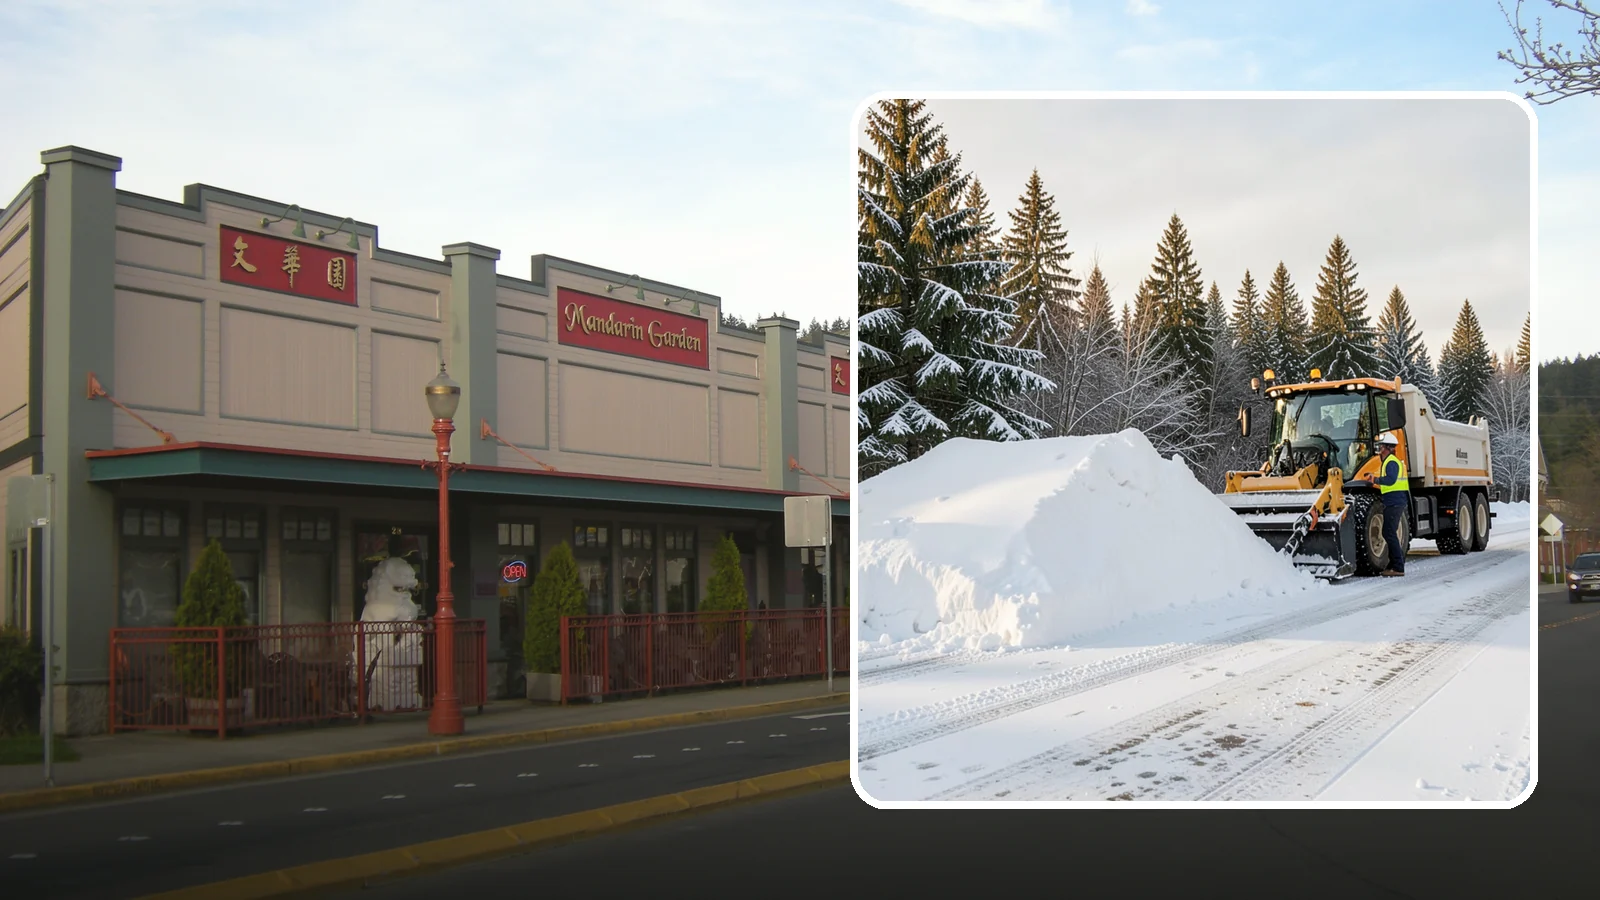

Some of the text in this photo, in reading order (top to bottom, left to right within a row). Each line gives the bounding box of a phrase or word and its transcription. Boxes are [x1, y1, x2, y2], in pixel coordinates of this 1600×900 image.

[230, 235, 346, 291] 文華園
[564, 302, 701, 352] Mandarin Garden
[834, 363, 846, 387] 文
[503, 565, 527, 578] OPEN
